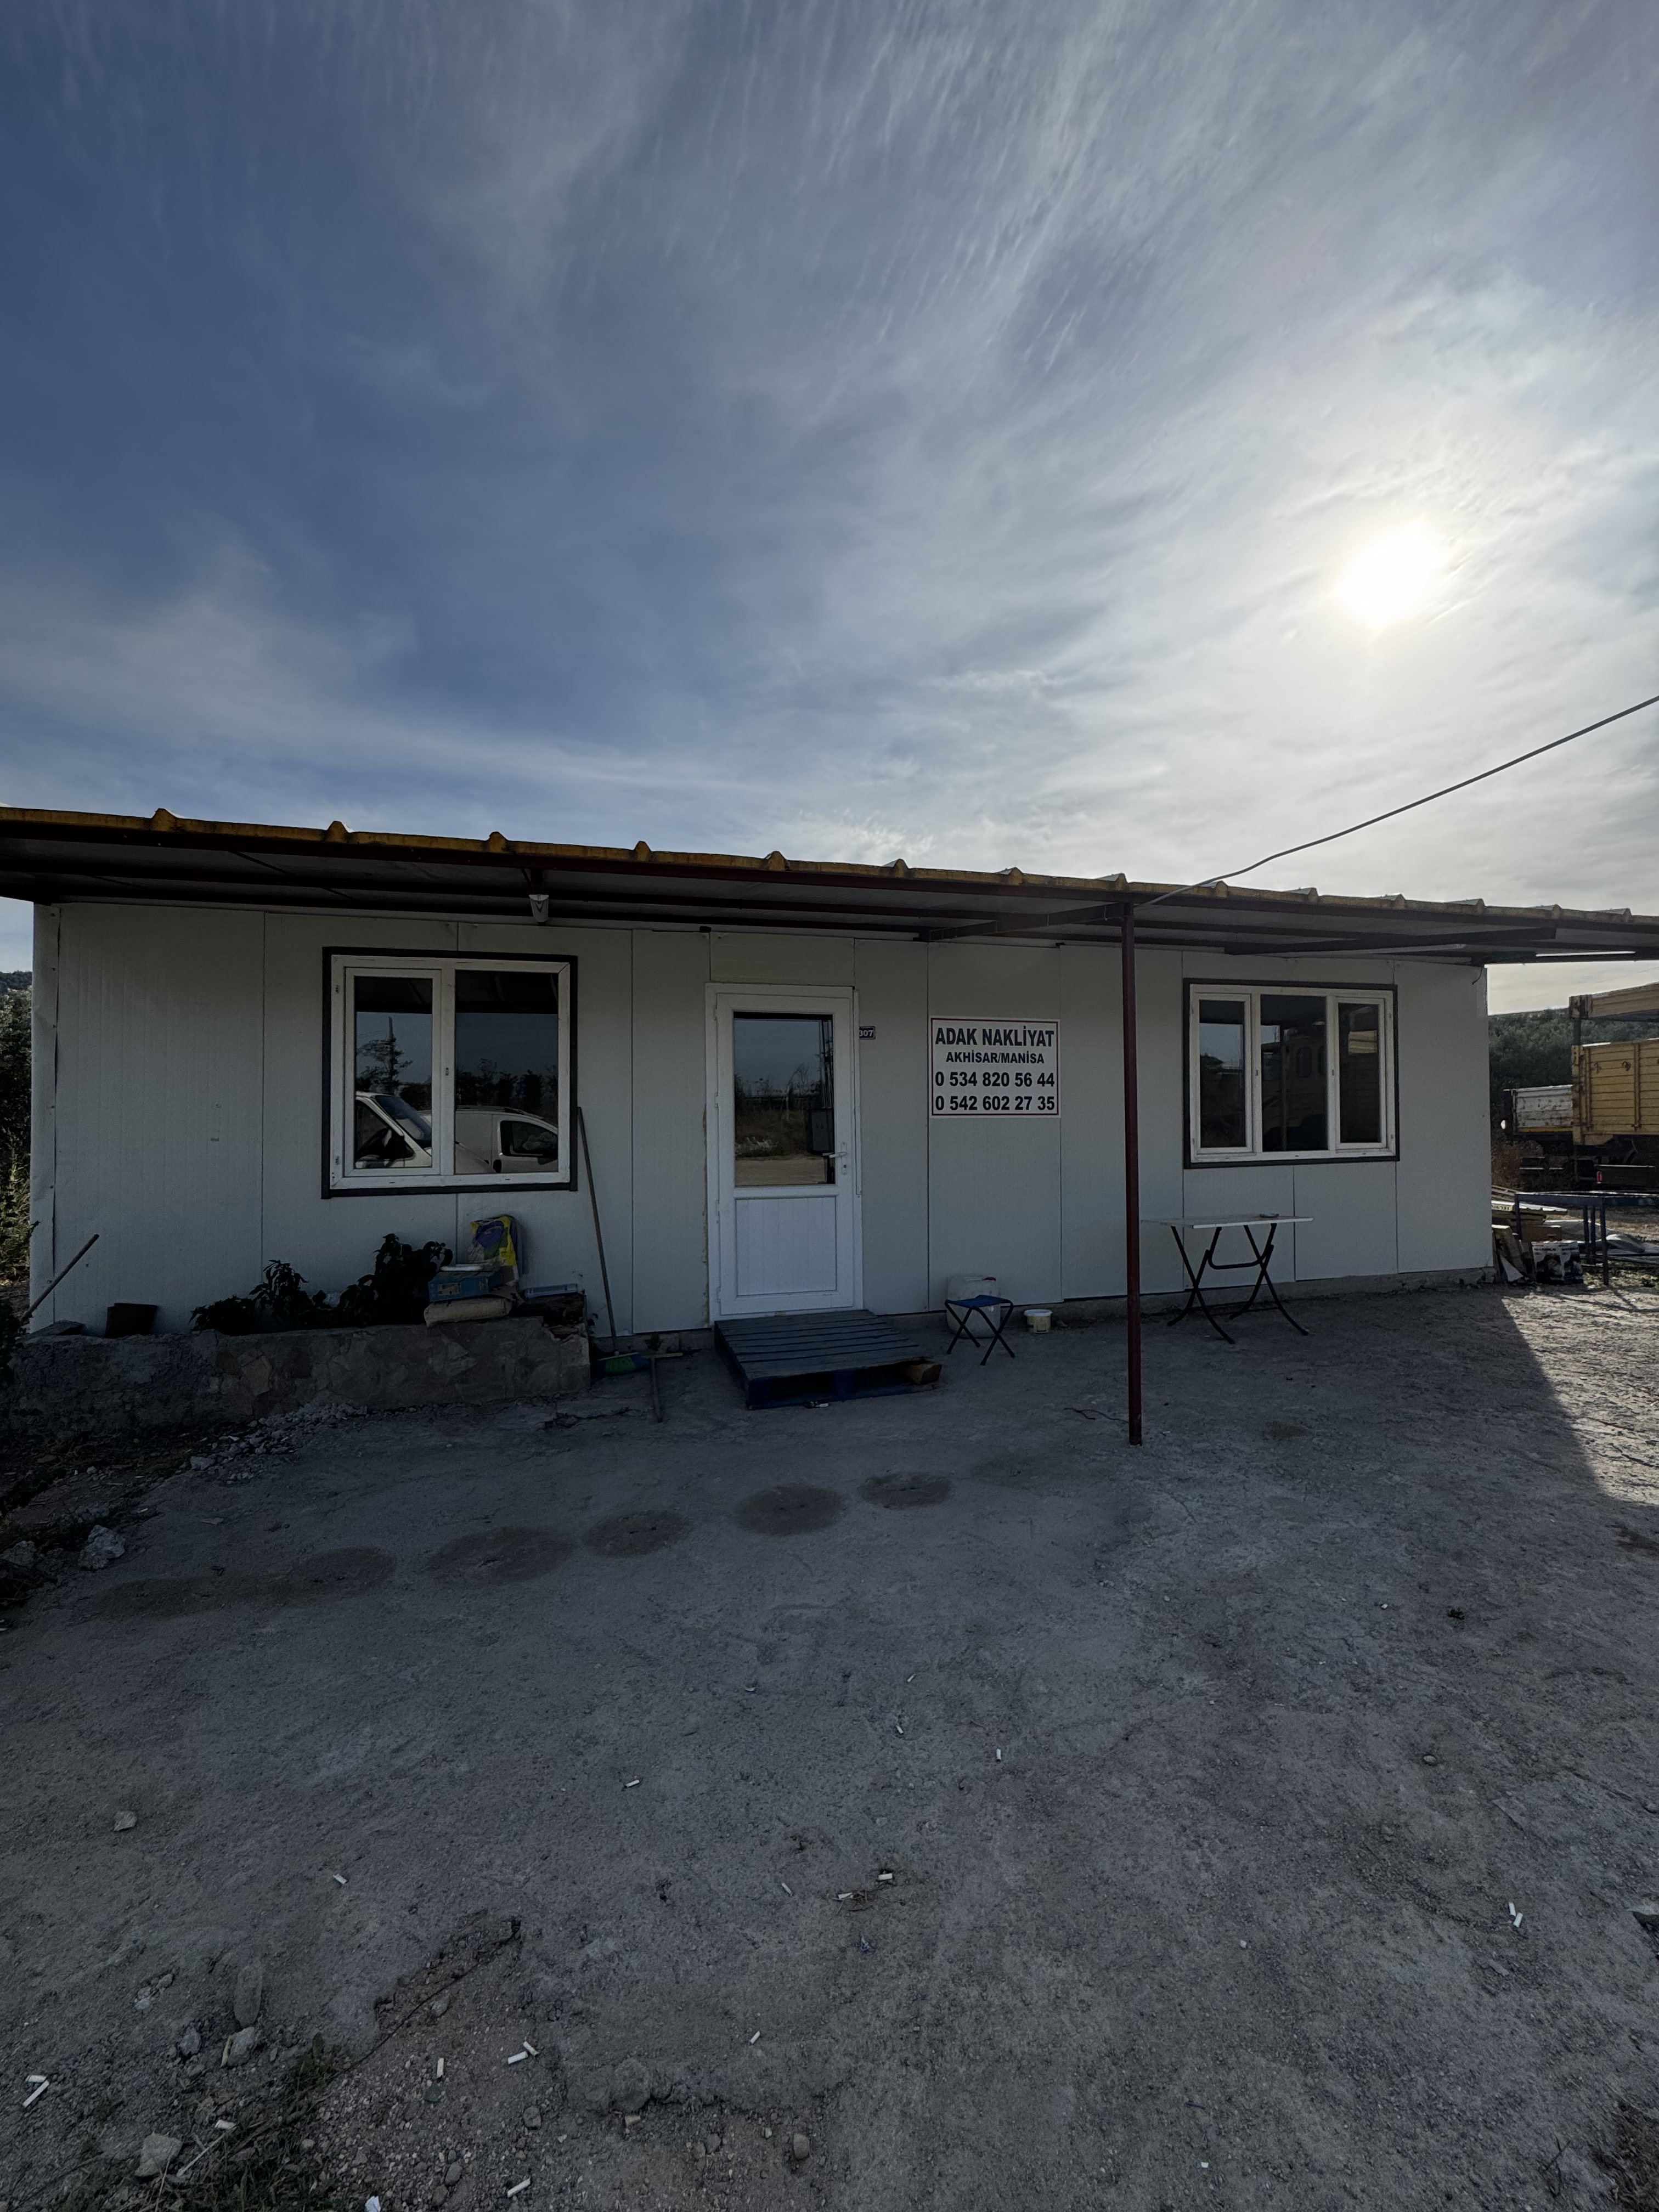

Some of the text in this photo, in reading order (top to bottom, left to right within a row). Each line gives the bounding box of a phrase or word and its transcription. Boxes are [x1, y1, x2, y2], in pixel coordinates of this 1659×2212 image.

[935, 1025, 1054, 1047] ADAK NAKLİYAT
[945, 1049, 1045, 1064] AKHİSAR/MANİSA
[935, 1071, 1055, 1087] 0 534 820 56 44
[935, 1095, 1055, 1111] 0 542 602 27 35
